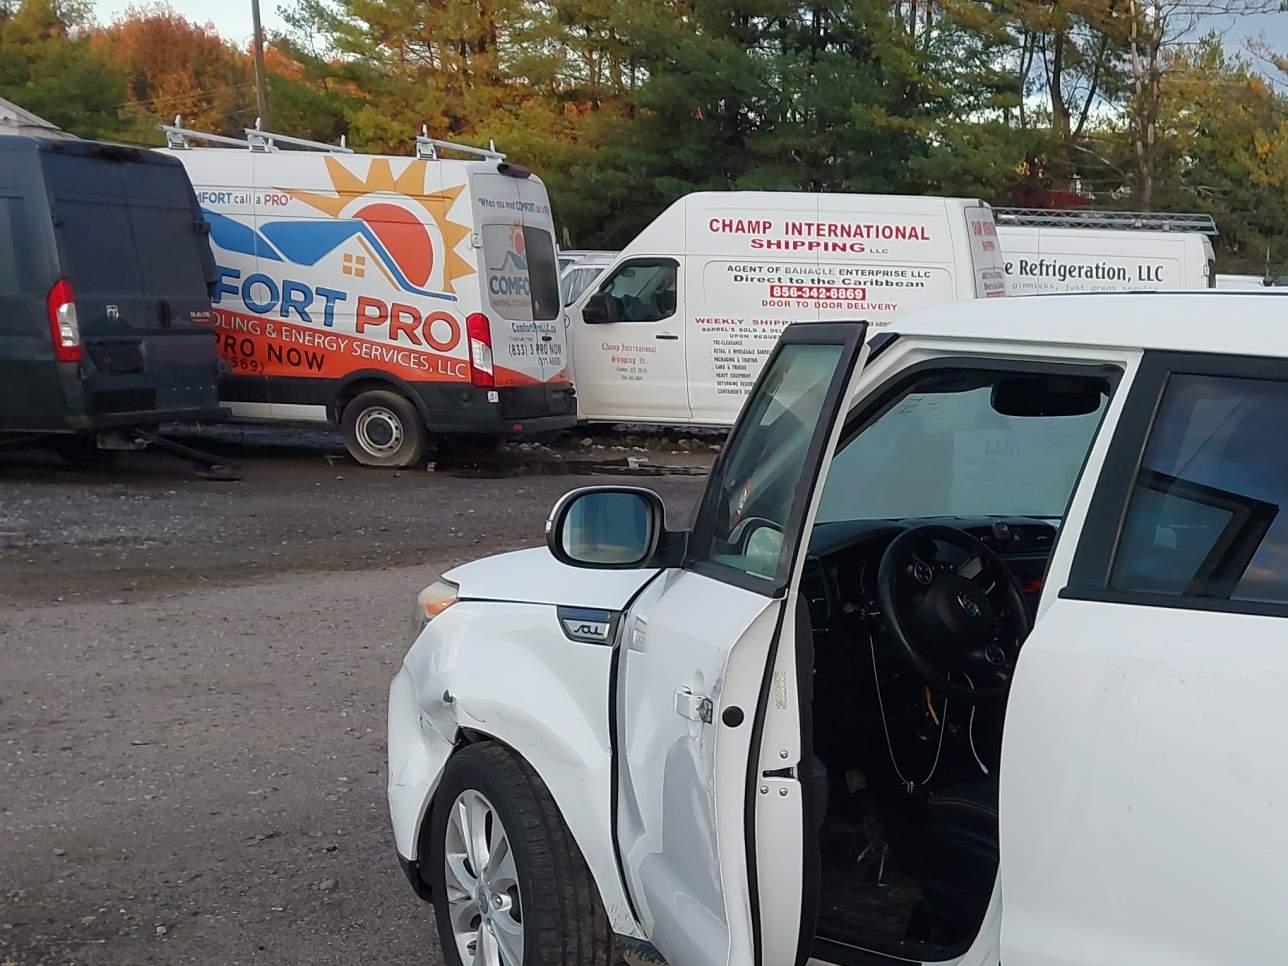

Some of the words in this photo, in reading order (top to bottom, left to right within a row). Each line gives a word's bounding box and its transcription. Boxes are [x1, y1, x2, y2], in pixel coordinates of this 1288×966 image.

[234, 194, 252, 204] call
[255, 196, 261, 205] a
[709, 218, 772, 235] CHAMP
[784, 221, 930, 241] INTERNATIONAL
[750, 238, 865, 253] SHIPPING
[727, 265, 763, 273] AGENT
[767, 266, 781, 274] OF
[839, 268, 907, 278] ENTERPRISE
[1019, 259, 1132, 283] Refrigeration,
[1137, 264, 1164, 282] LLC
[733, 274, 783, 284] Direct
[789, 276, 804, 285] to
[811, 277, 835, 286] the
[841, 277, 925, 288] Caribbean
[773, 286, 863, 299] 856-342-6869
[761, 300, 791, 308] DOOR
[847, 302, 898, 311] DELIVERY
[355, 295, 461, 352] PRO
[695, 317, 745, 325] WEEKLY
[265, 322, 278, 338] &
[282, 326, 348, 352] ENERGY
[352, 340, 433, 373] SERVICES,
[438, 359, 467, 379] LLC
[268, 342, 326, 372] NOW
